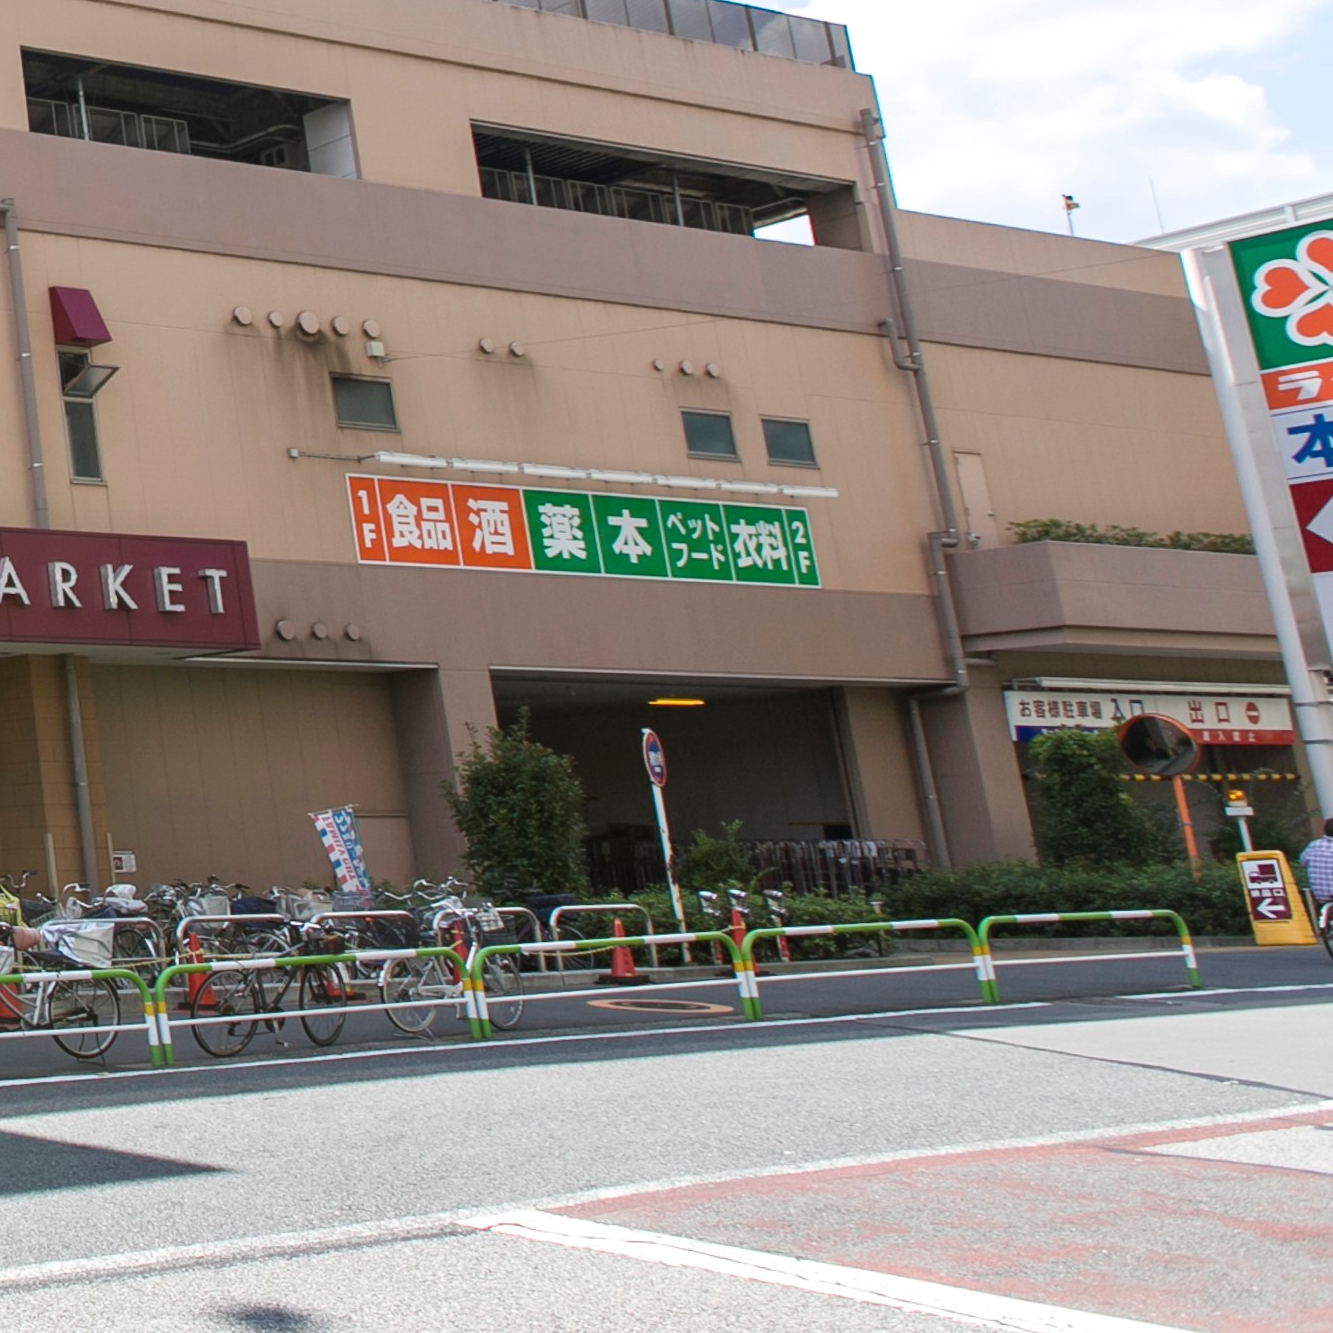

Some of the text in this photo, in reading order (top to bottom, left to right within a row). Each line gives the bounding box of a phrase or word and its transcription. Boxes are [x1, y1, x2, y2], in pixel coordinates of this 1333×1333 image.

[1277, 370, 1333, 401] ラ
[386, 493, 454, 551] 食品
[466, 497, 516, 557] 酒
[537, 502, 588, 560] 薬
[607, 509, 653, 564] 本
[666, 512, 721, 541] ペット
[670, 542, 726, 570] フード
[730, 518, 789, 571] 衣料
[1018, 699, 1103, 719] お客様駐車場
[1187, 699, 1231, 724] 出口
